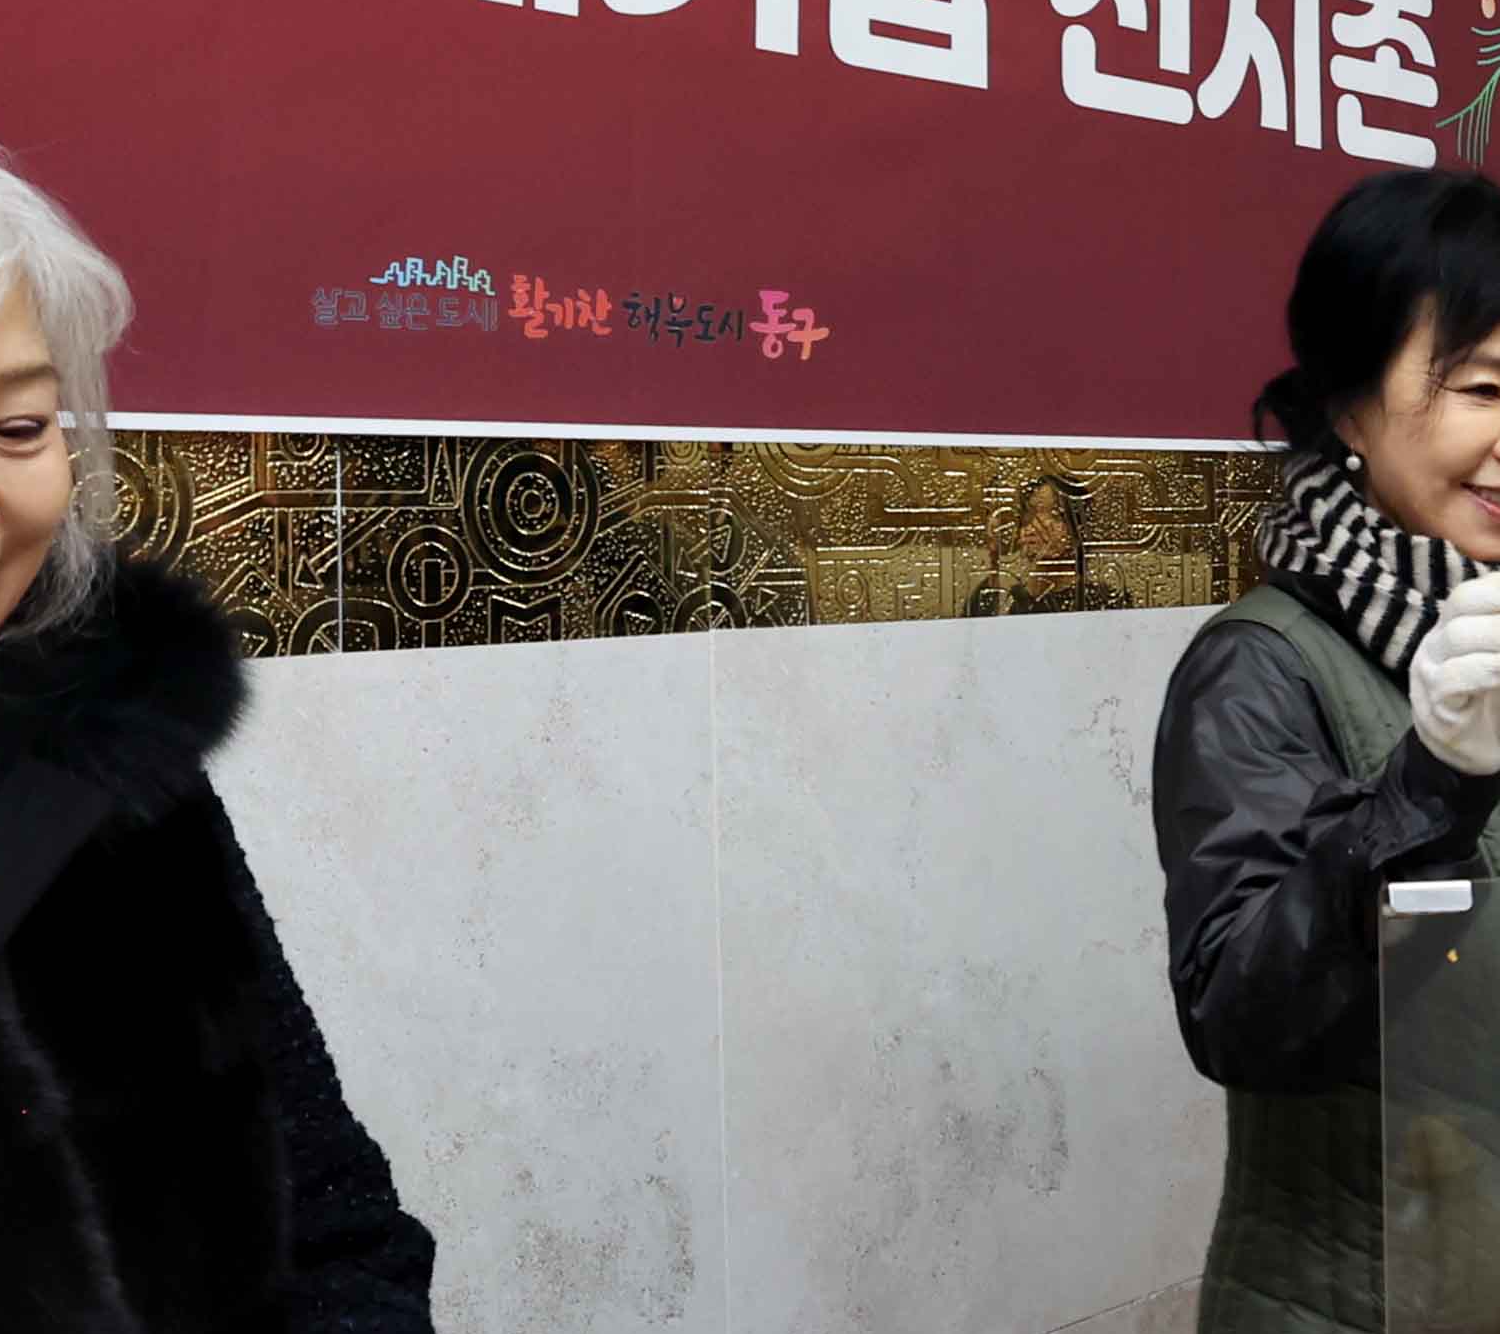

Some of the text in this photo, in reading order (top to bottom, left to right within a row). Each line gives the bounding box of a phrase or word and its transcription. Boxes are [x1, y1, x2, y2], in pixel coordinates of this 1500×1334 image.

[311, 287, 369, 326] 살고
[378, 290, 430, 330] 싶은
[507, 274, 613, 339] 활기찬
[622, 292, 746, 348] 행복도시
[749, 290, 830, 360] 동구
